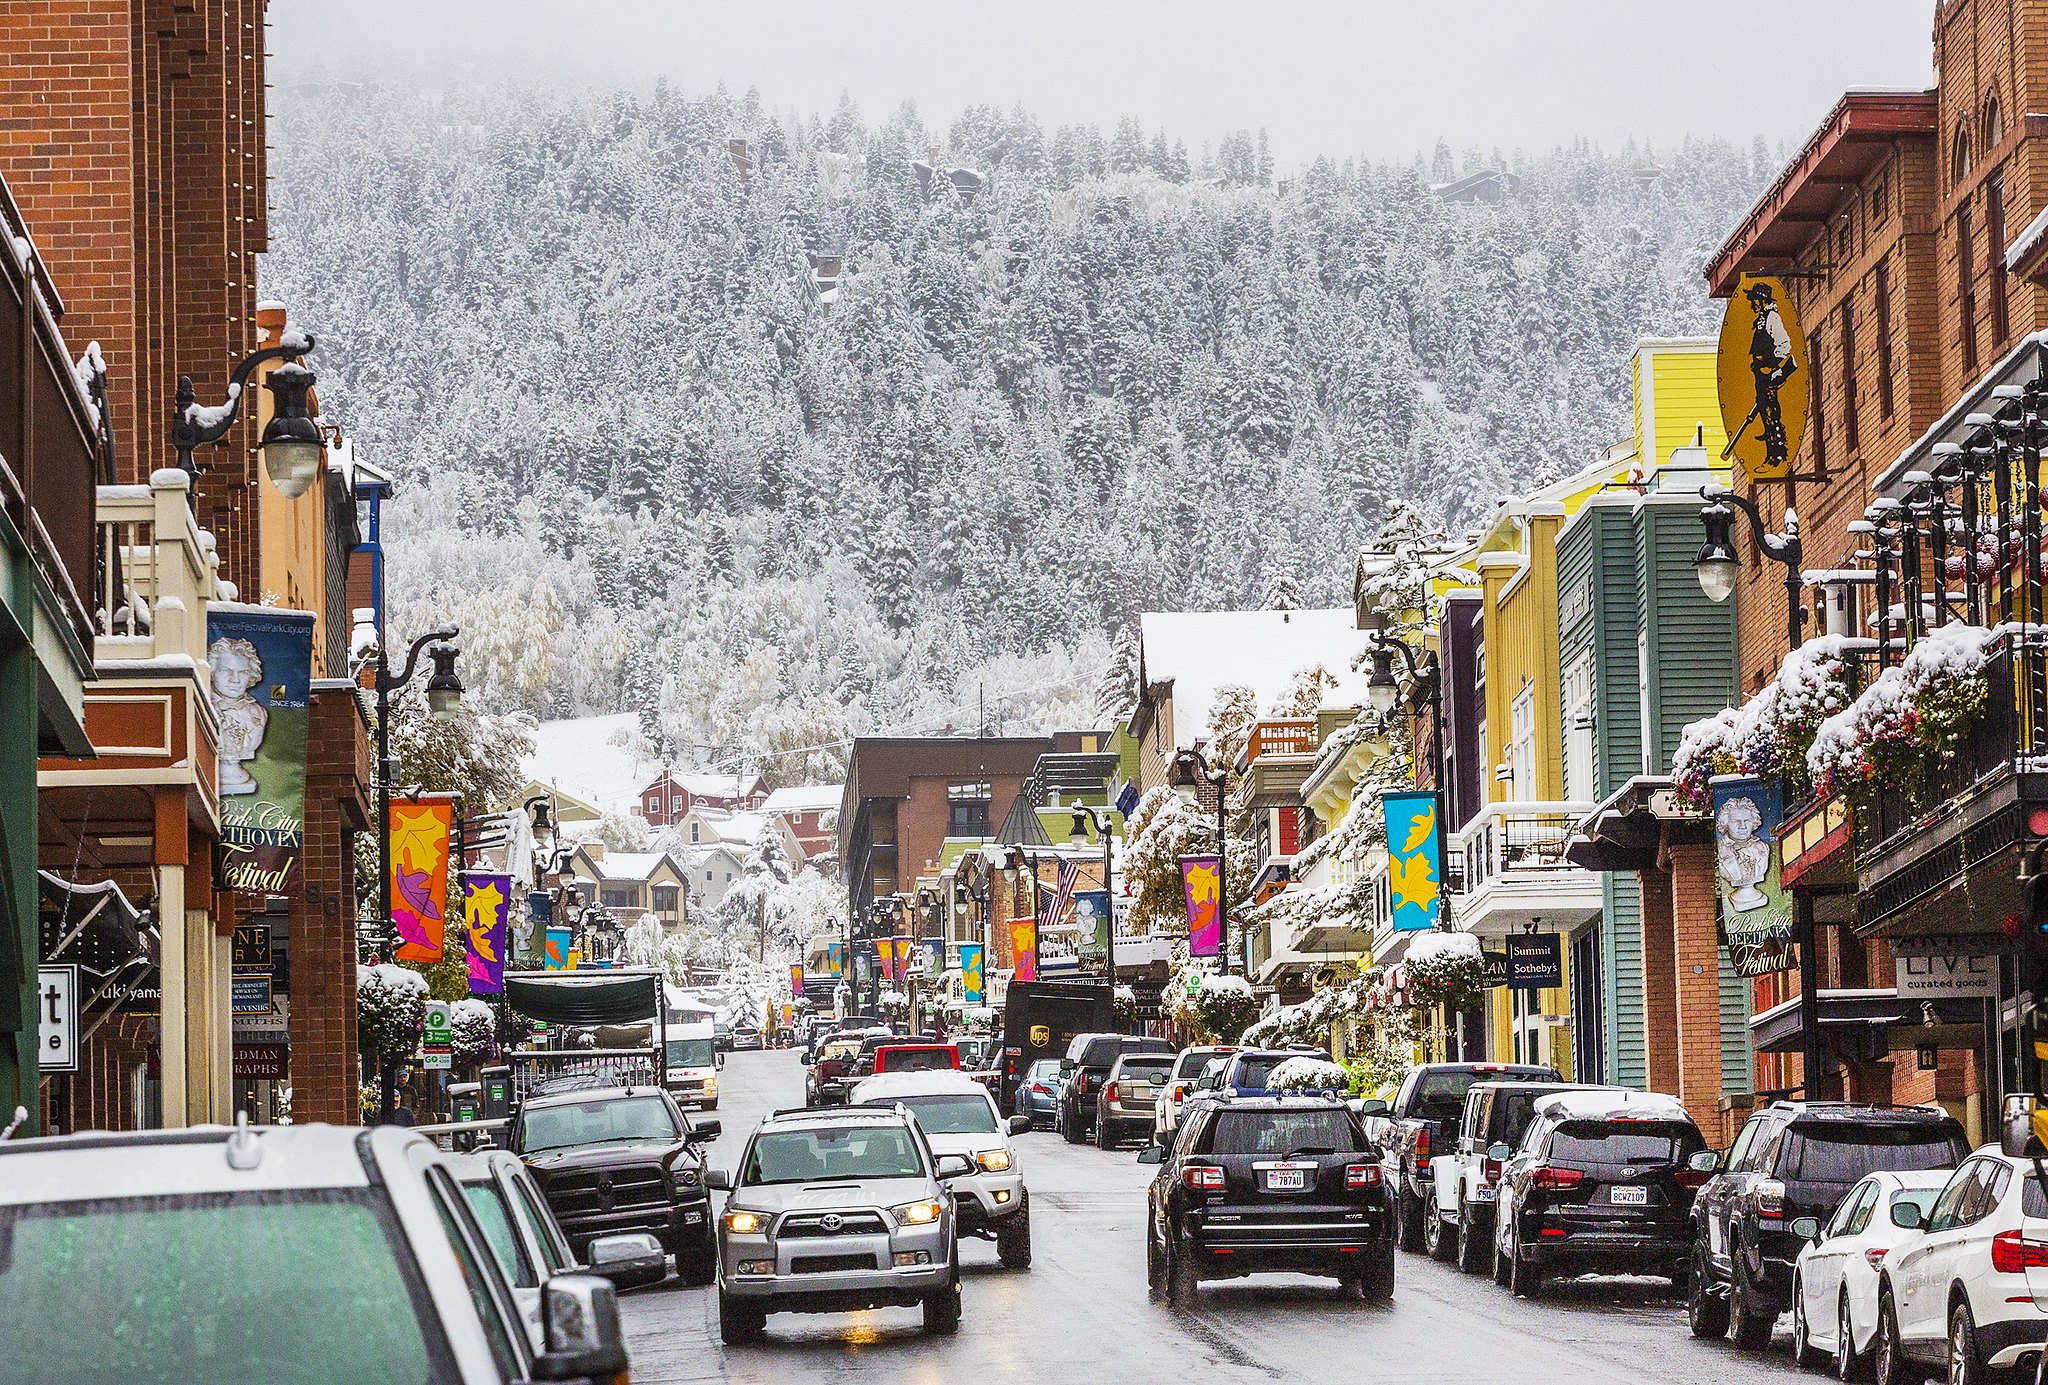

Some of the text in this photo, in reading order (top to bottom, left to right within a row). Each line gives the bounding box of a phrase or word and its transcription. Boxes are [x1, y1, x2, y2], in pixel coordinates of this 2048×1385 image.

[254, 801, 300, 839] City
[220, 843, 294, 892] Festival
[1513, 945, 1551, 956] Summit
[1733, 942, 1789, 976] Festival
[1514, 962, 1558, 974] Sotheby's
[1907, 979, 1988, 989] curated goods
[432, 1014, 442, 1025] P
[426, 1031, 434, 1041] 3
[1613, 1192, 1645, 1202] 8CWZ109
